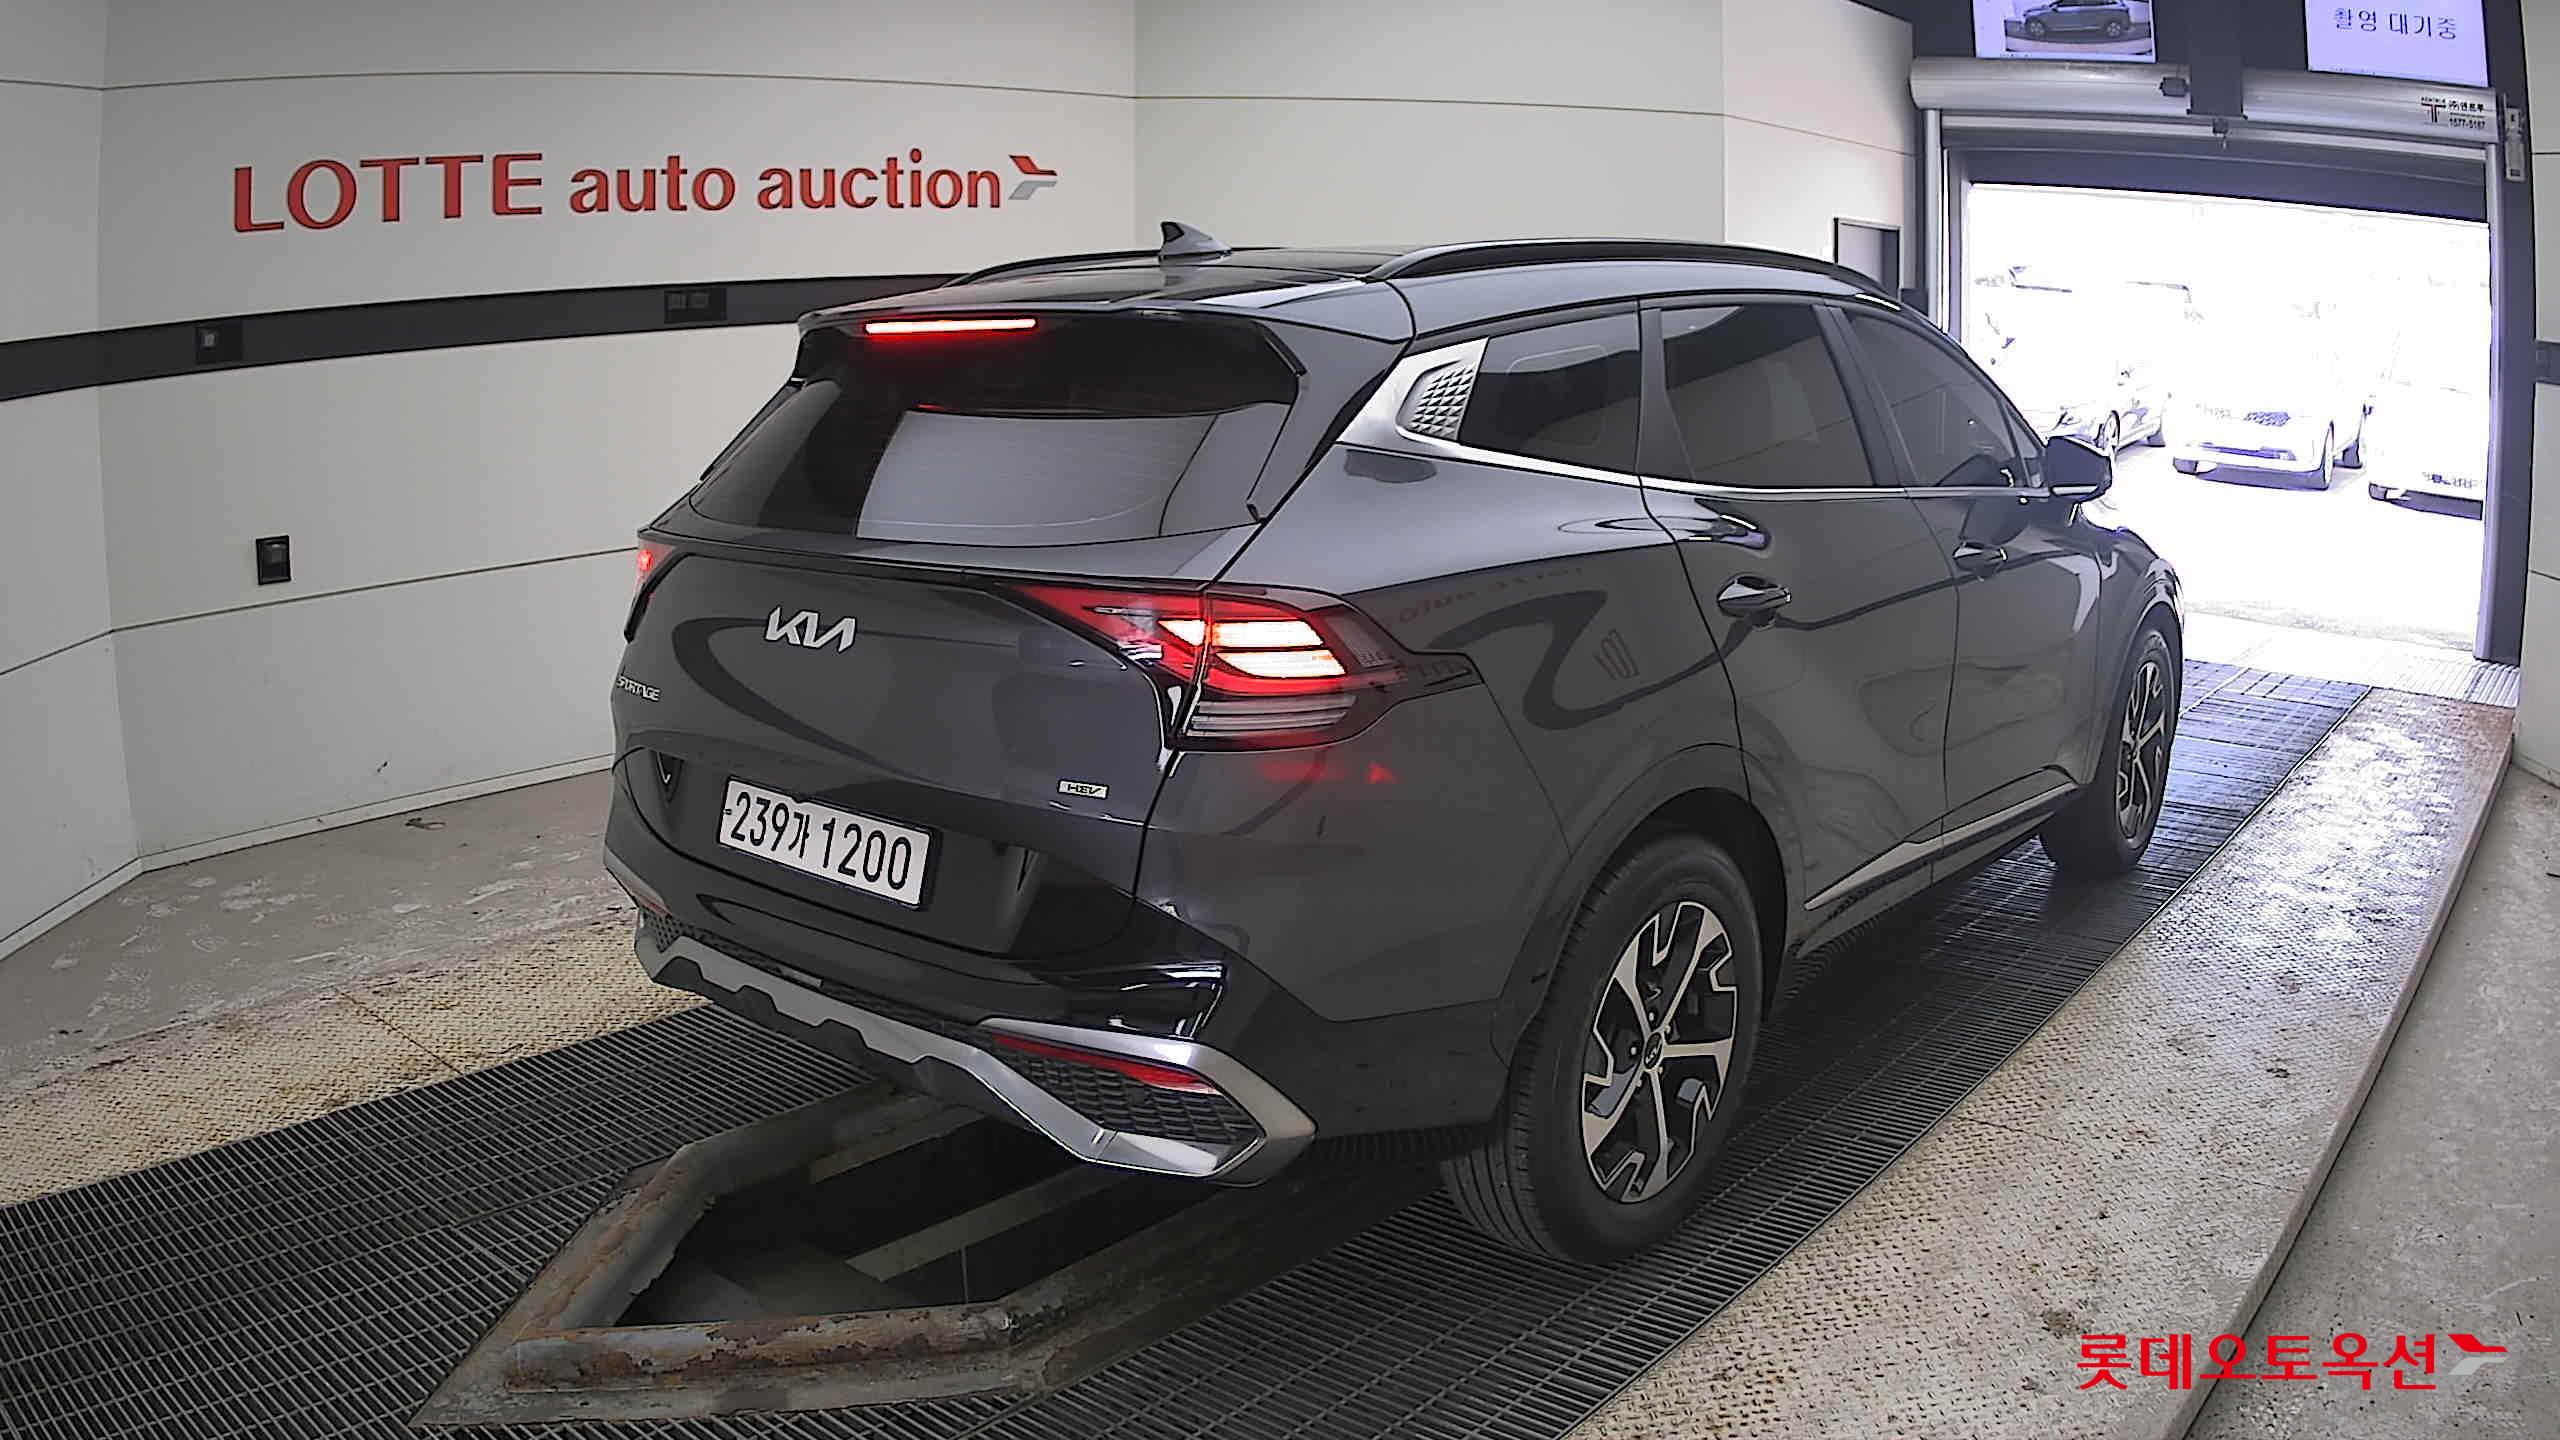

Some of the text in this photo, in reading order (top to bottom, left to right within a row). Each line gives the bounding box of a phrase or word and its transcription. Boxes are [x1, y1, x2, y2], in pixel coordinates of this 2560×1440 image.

[2389, 12, 2457, 40] 대기중
[234, 148, 1001, 232] LOTTE auto auction
[764, 606, 858, 653] KIA
[1067, 783, 1102, 795] HEV
[822, 817, 912, 890] 1200
